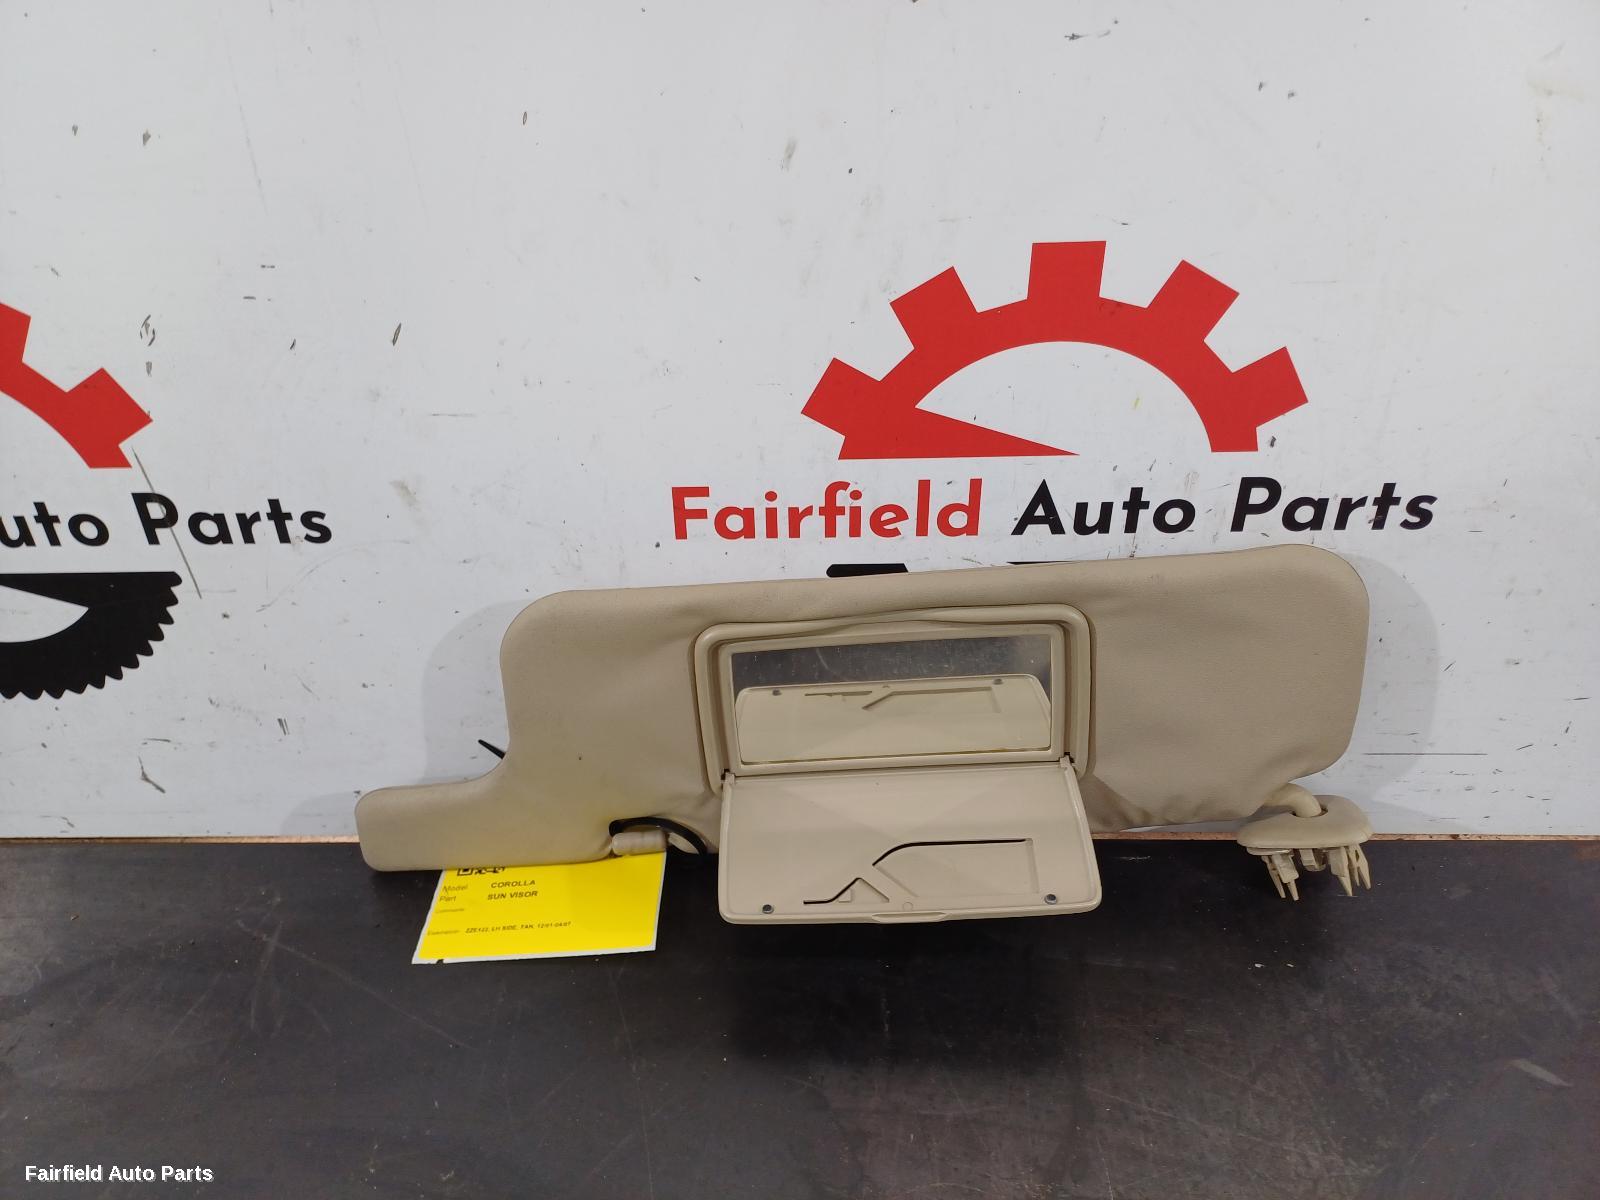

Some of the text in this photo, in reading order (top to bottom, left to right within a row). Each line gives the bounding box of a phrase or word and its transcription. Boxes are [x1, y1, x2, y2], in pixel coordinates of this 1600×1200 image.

[0, 492, 332, 549] uto Parts
[672, 477, 1438, 541] Fairfield Auto Parts
[487, 892, 507, 901] SUN
[510, 890, 538, 899] VISOR
[490, 879, 536, 889] COROLLA
